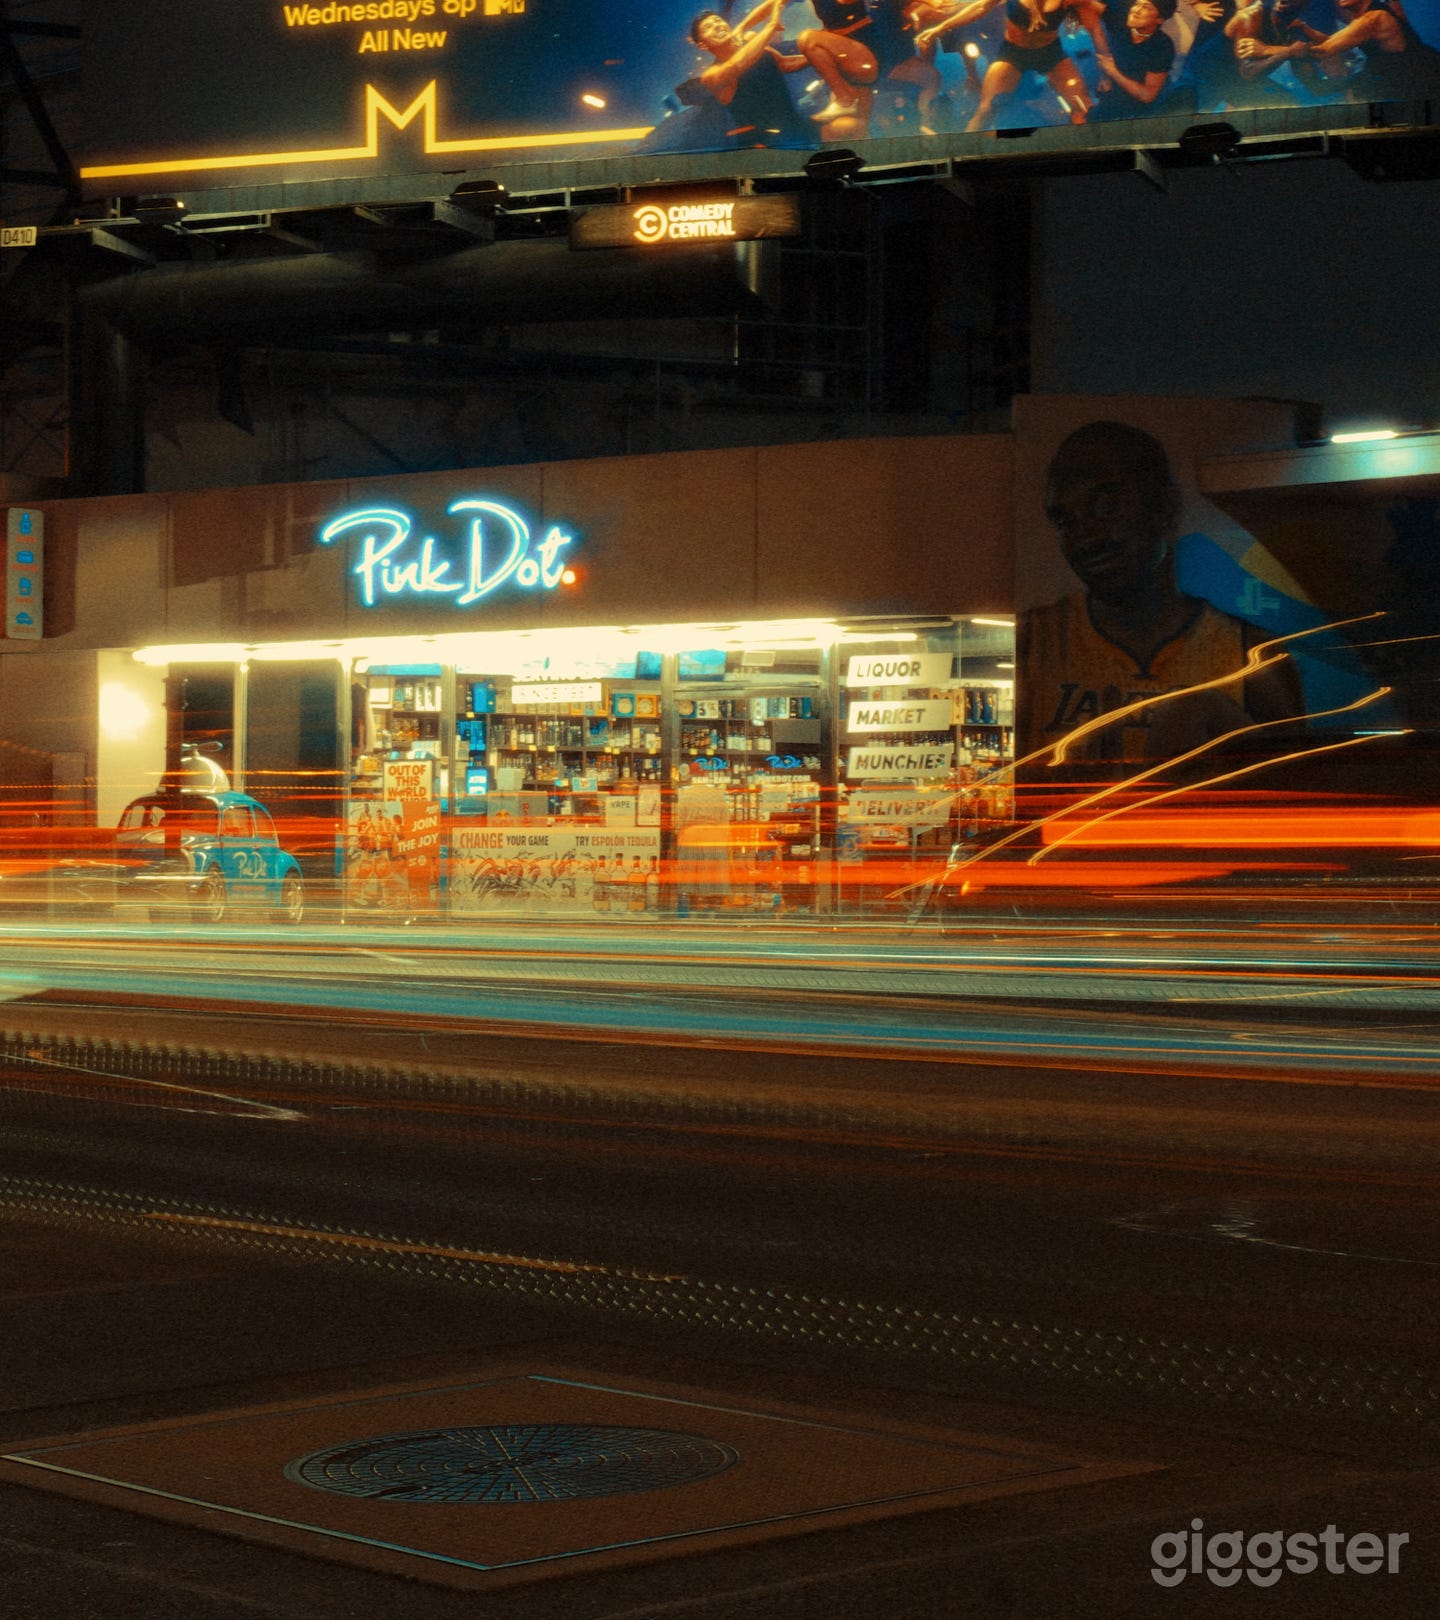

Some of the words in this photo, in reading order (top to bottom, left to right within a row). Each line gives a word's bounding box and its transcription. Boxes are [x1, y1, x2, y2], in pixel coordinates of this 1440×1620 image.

[283, 0, 436, 27] Wednesdays
[359, 30, 388, 53] All
[392, 29, 447, 50] New
[668, 203, 735, 222] COMEDY
[668, 219, 736, 239] CENTRAL
[320, 508, 464, 606] Pink
[856, 661, 922, 678] LIQUOR
[855, 708, 926, 726] MARKET
[854, 753, 946, 770] MUNCHIES
[388, 765, 411, 777] OUT
[412, 765, 427, 776] OF
[395, 776, 420, 787] THIS
[411, 816, 438, 832] JOIN
[397, 840, 417, 853] THE
[417, 833, 439, 848] JOY
[459, 832, 503, 849] CHANGE
[506, 836, 527, 847] YOUR
[528, 835, 549, 846] GAME
[575, 836, 590, 847] TRY
[627, 836, 657, 847] TEQUILA
